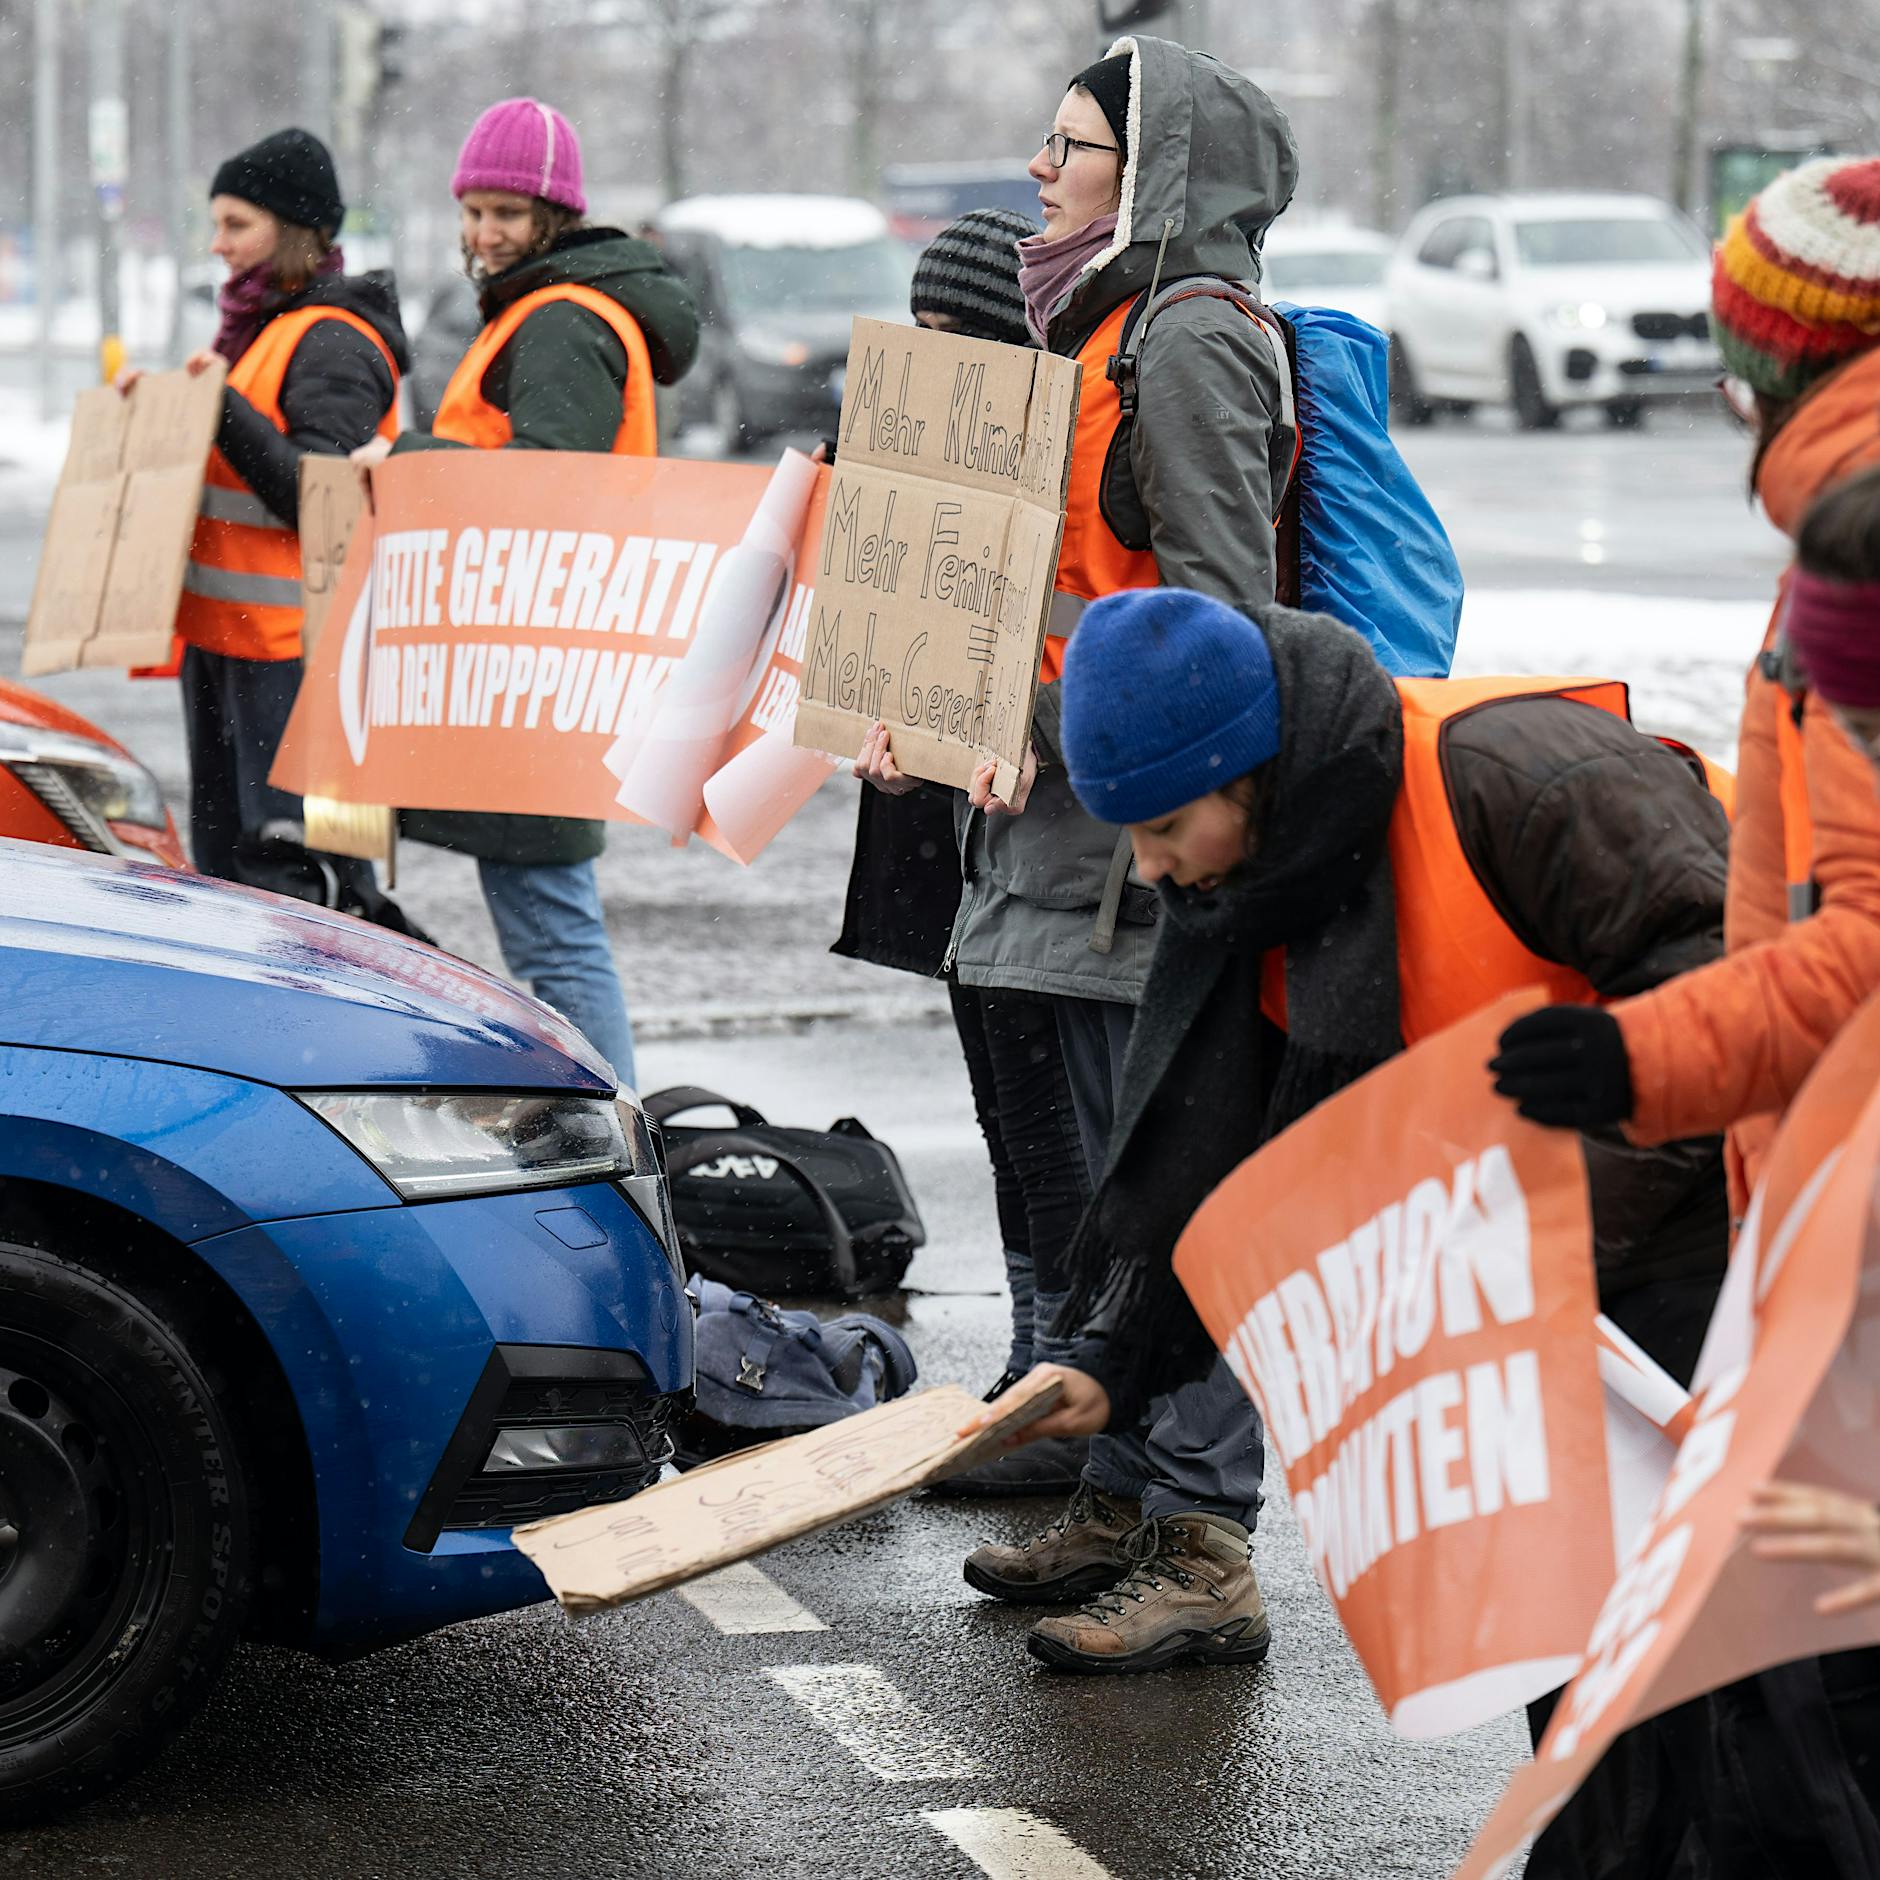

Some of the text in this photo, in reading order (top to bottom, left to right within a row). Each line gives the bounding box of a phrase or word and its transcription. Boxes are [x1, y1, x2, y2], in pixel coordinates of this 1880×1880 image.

[844, 346, 926, 457] Mehr
[448, 526, 722, 640] GENERATI
[824, 477, 907, 593] Mehr
[401, 643, 449, 727] DEN
[805, 605, 891, 720] Mehr
[143, 1335, 231, 1507] WINTER
